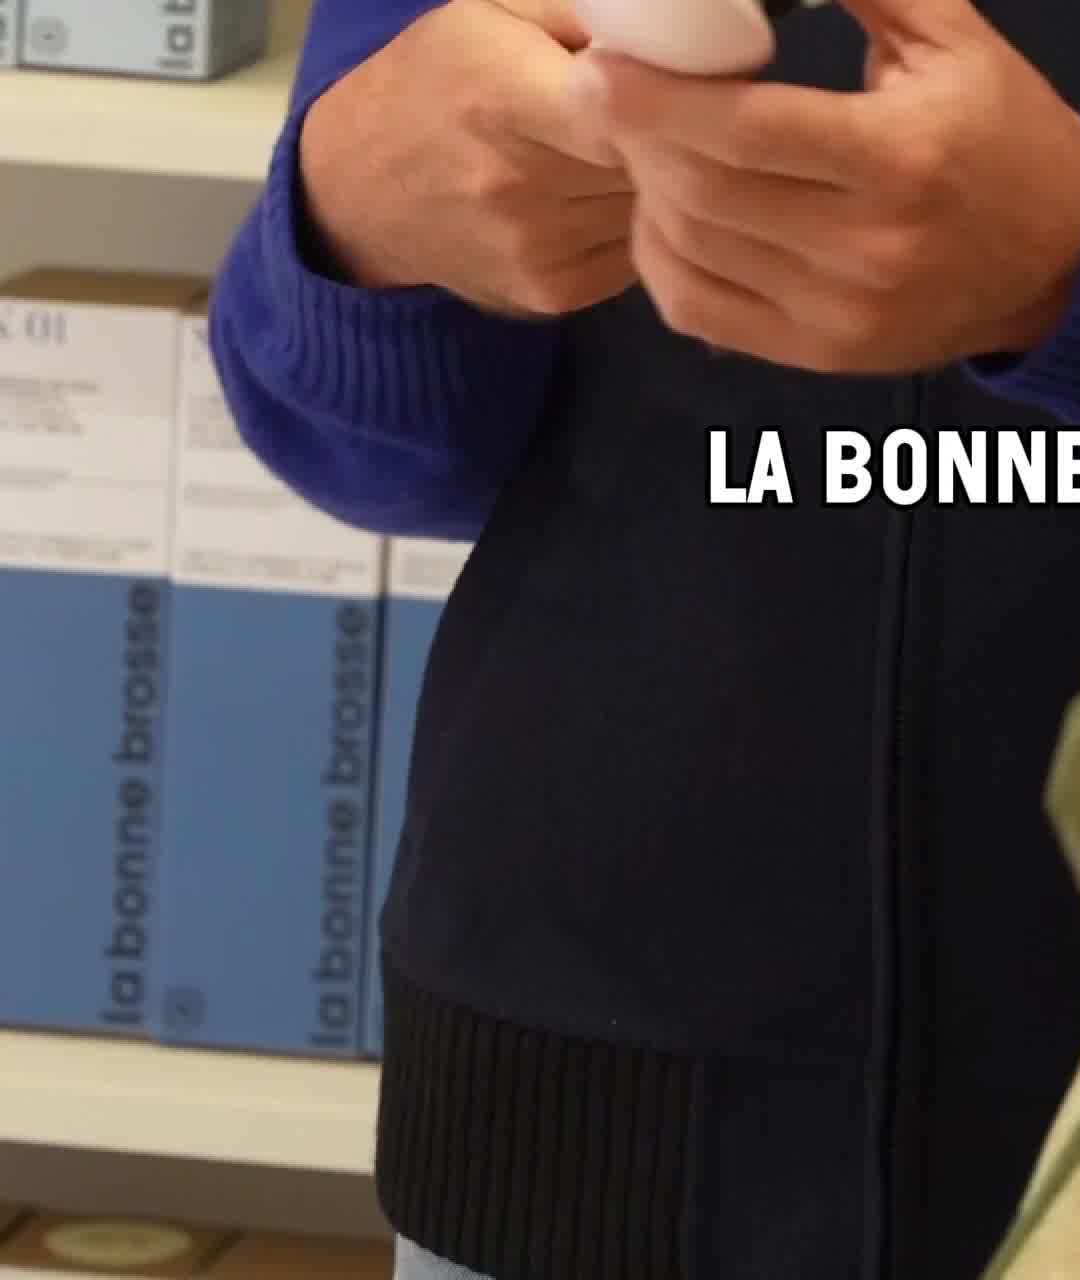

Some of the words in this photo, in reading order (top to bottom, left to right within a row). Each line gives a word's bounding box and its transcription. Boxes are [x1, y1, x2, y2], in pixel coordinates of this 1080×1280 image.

[158, 24, 196, 73] la
[112, 583, 161, 767] brosse
[322, 602, 373, 787] brosse
[101, 778, 151, 965] bonne
[312, 797, 358, 982] bonne
[99, 978, 143, 1025] la
[308, 994, 348, 1051] la
